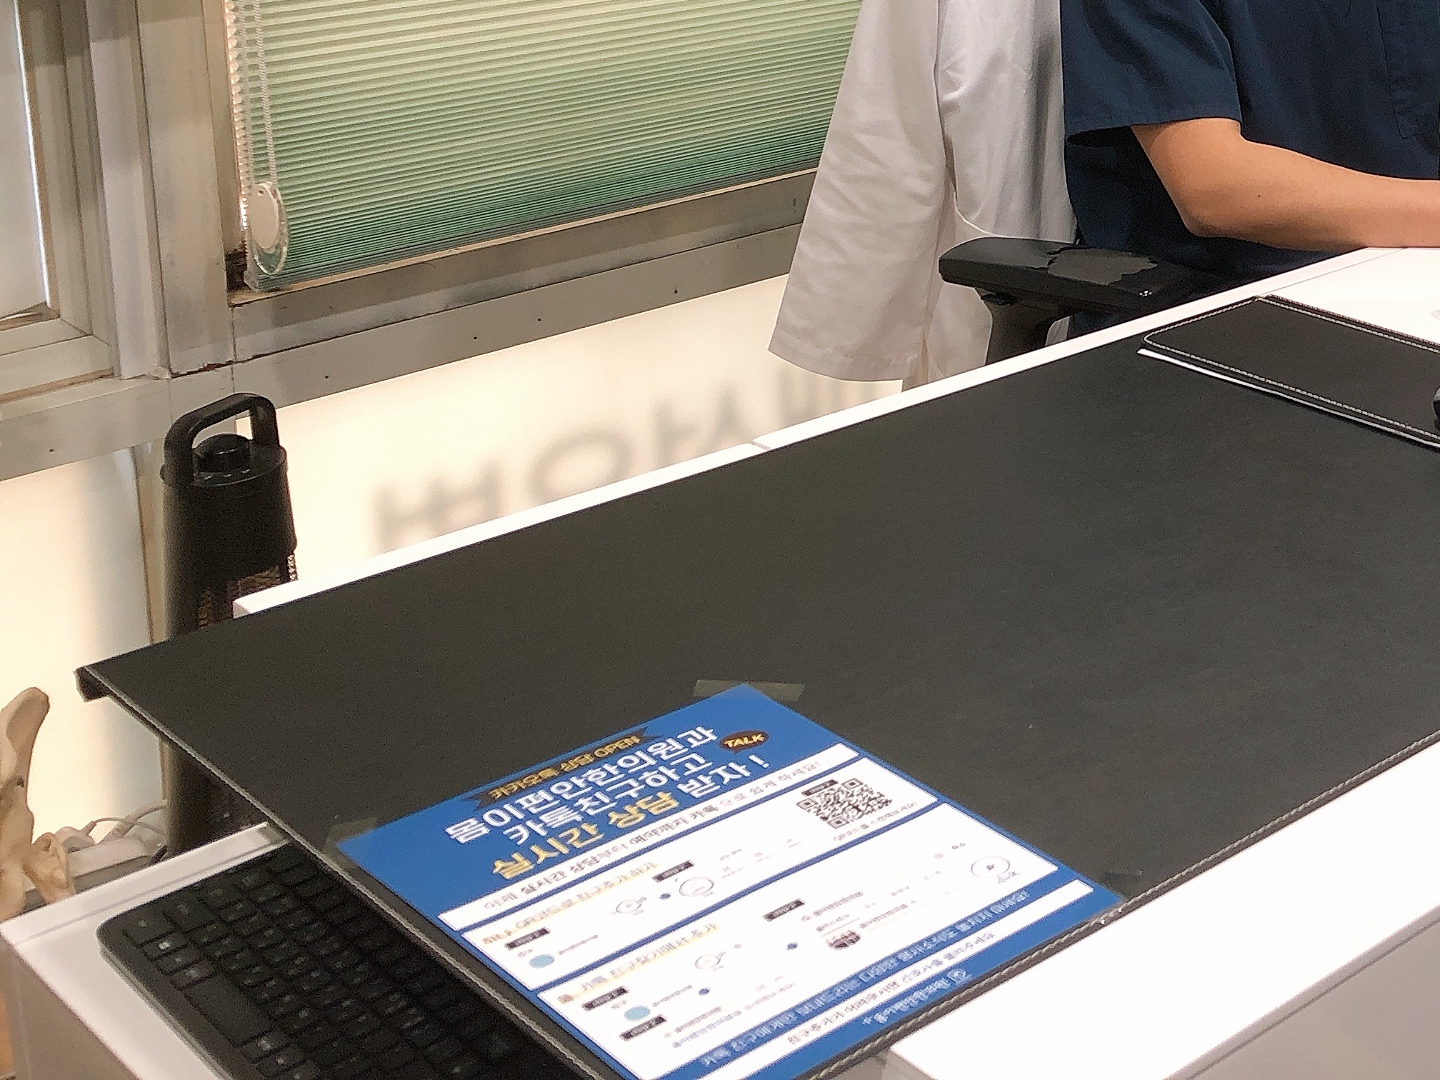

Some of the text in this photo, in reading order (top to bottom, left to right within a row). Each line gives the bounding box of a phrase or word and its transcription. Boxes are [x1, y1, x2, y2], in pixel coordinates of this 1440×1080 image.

[444, 726, 718, 844] 몸이편안한의원과
[594, 735, 640, 757] OPEN
[723, 733, 766, 748] TALK
[493, 822, 605, 879] 실시간
[608, 791, 679, 829] 상담
[677, 761, 751, 798] 받자
[503, 752, 713, 845] 카톡친구하고
